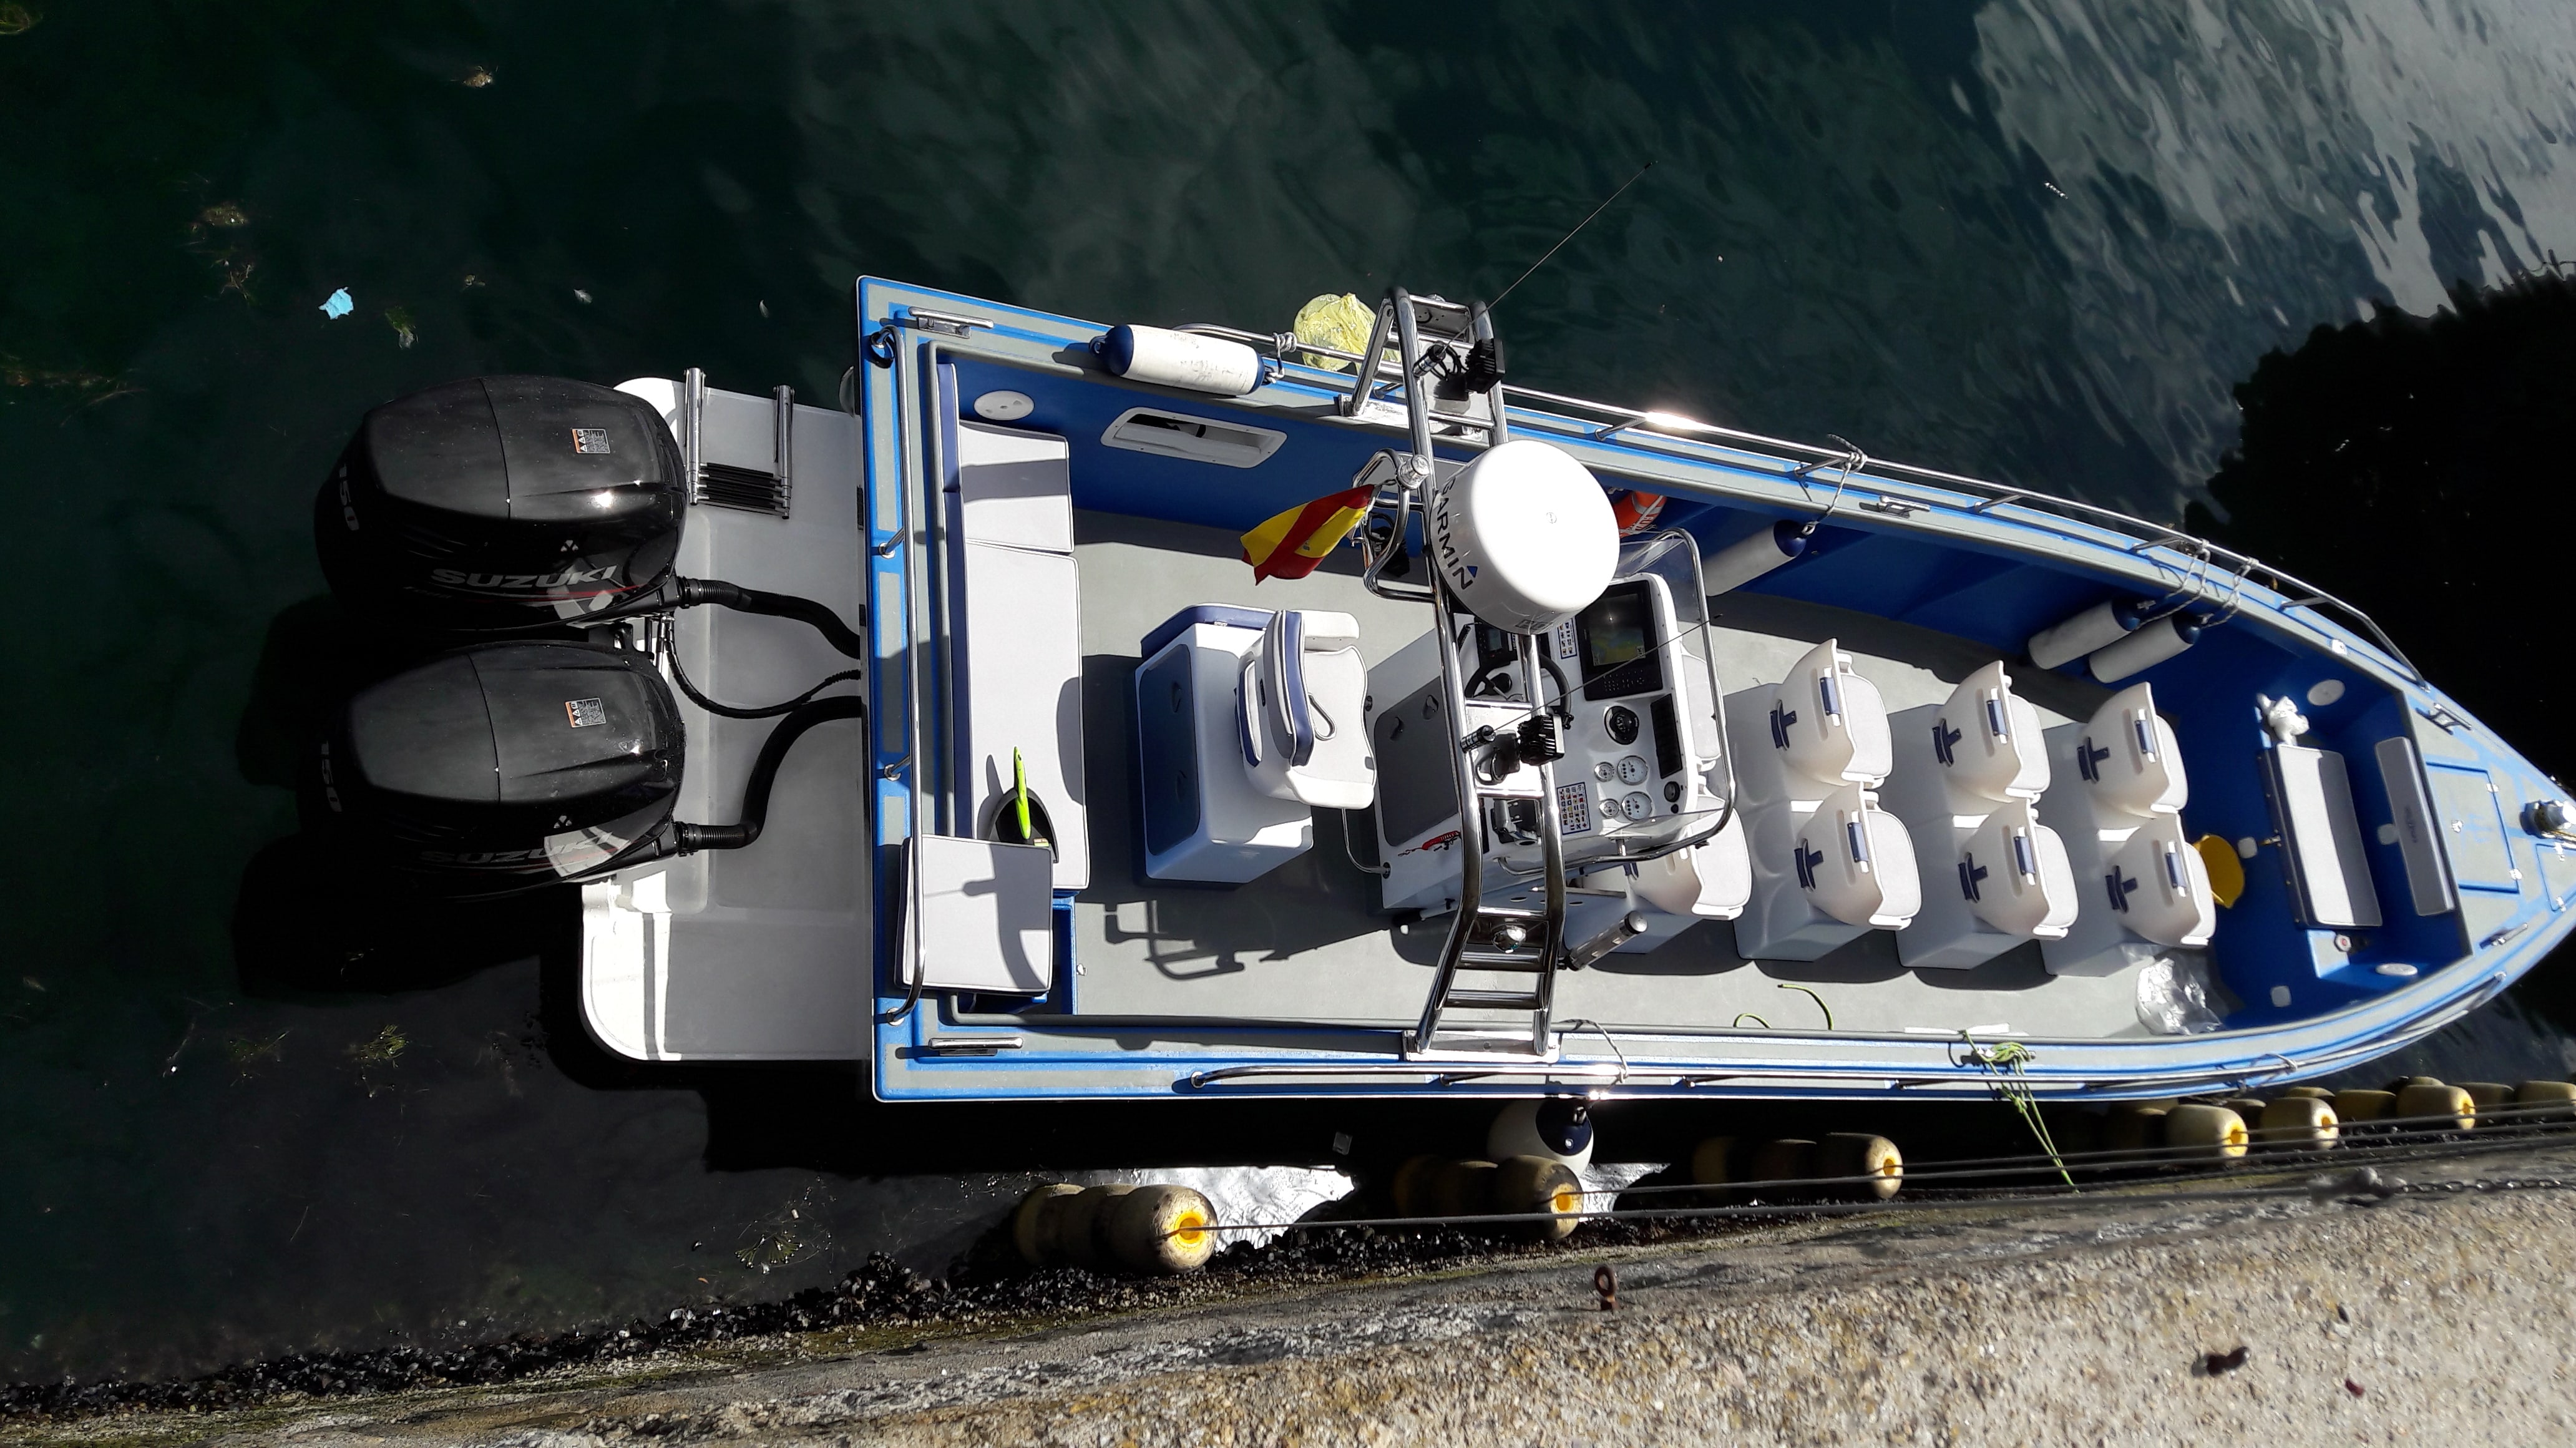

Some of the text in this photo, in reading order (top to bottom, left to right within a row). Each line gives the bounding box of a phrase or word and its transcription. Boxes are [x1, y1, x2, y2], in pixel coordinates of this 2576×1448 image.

[1435, 476, 1475, 590] GARMIN
[431, 564, 618, 588] SUZUKI
[419, 832, 613, 863] SUZUKI
